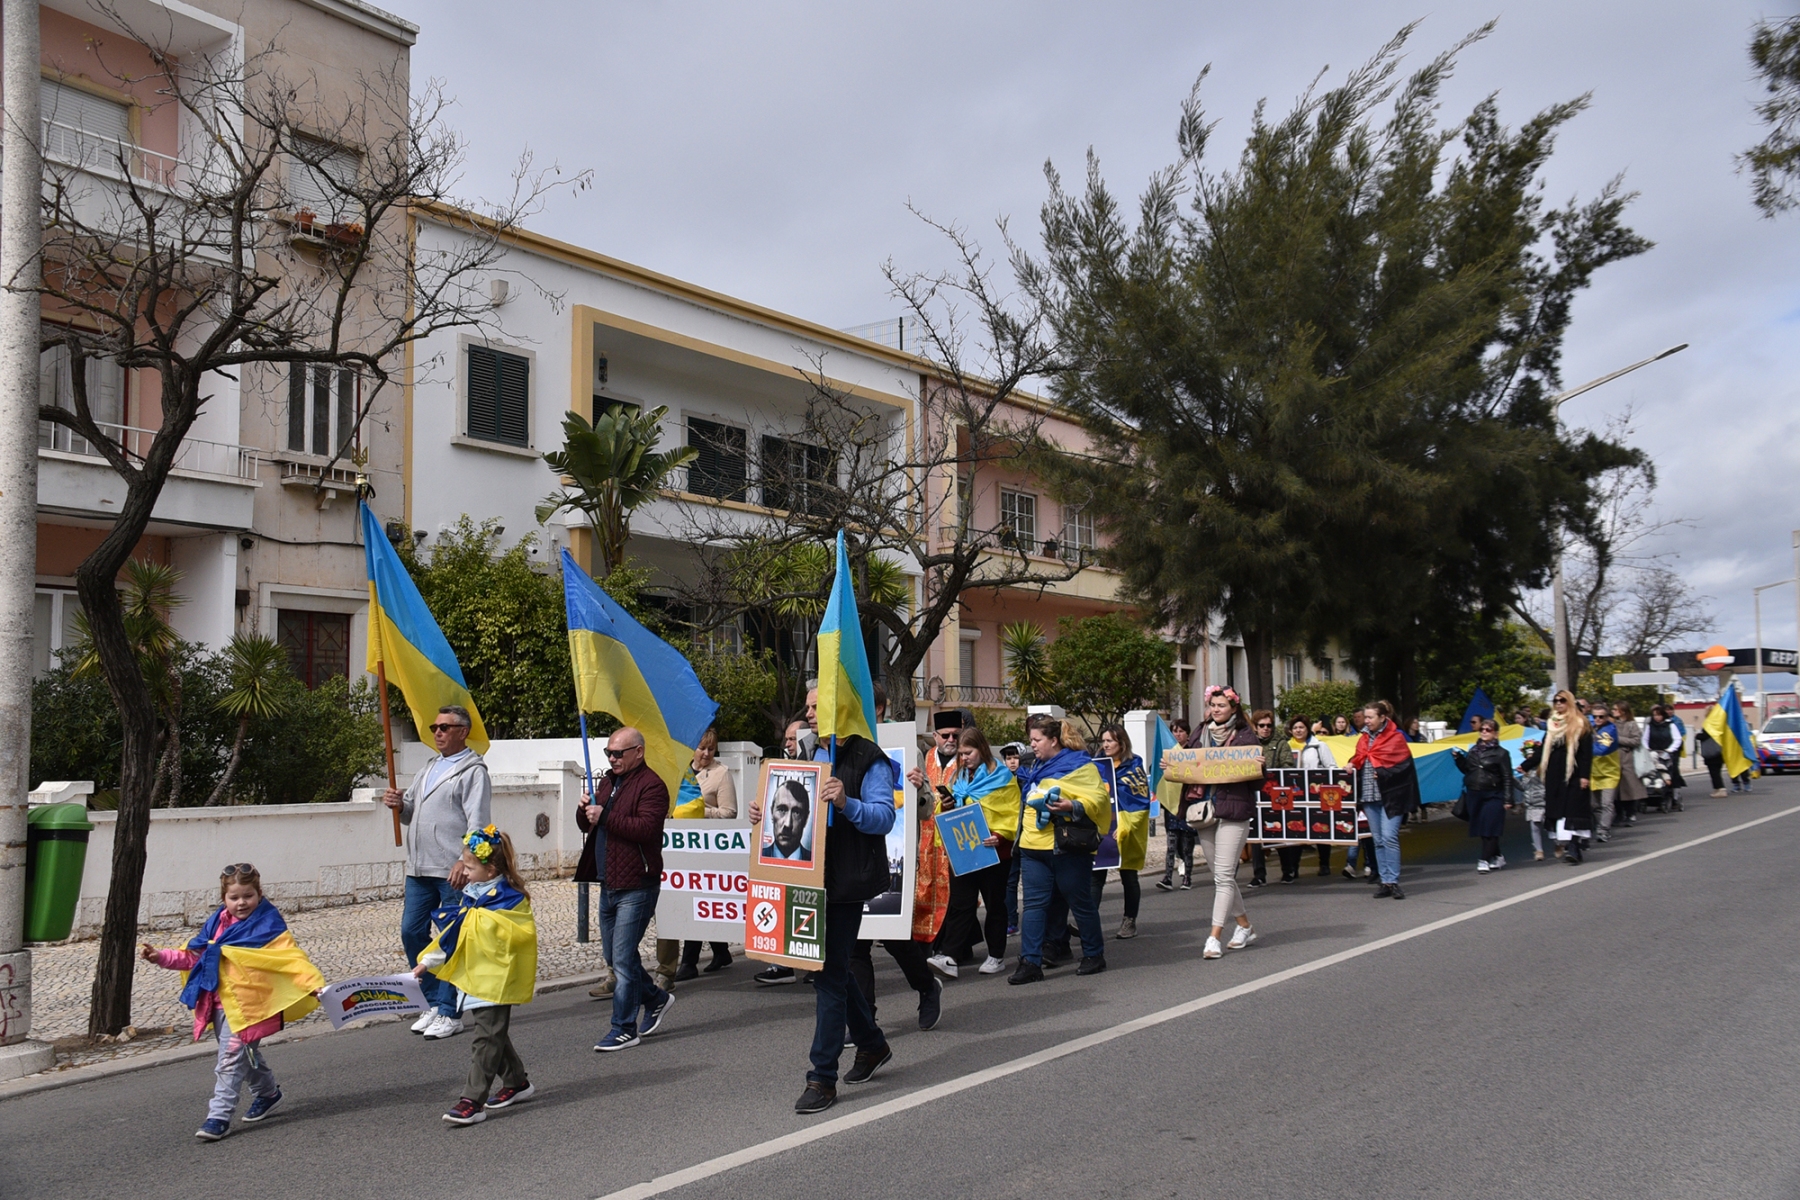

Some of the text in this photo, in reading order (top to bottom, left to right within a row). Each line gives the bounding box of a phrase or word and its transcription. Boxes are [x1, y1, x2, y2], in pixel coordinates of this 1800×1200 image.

[1168, 748, 1261, 762] NOVA KAKHOVKA
[1184, 766, 1193, 779] A
[1203, 761, 1258, 779] UCRÂNIA
[774, 775, 812, 793] TE
[662, 832, 752, 851] BRIGA
[751, 884, 781, 901] NEVER
[792, 889, 818, 905] 2022
[752, 935, 777, 952] 1939
[788, 940, 820, 959] AGAIN
